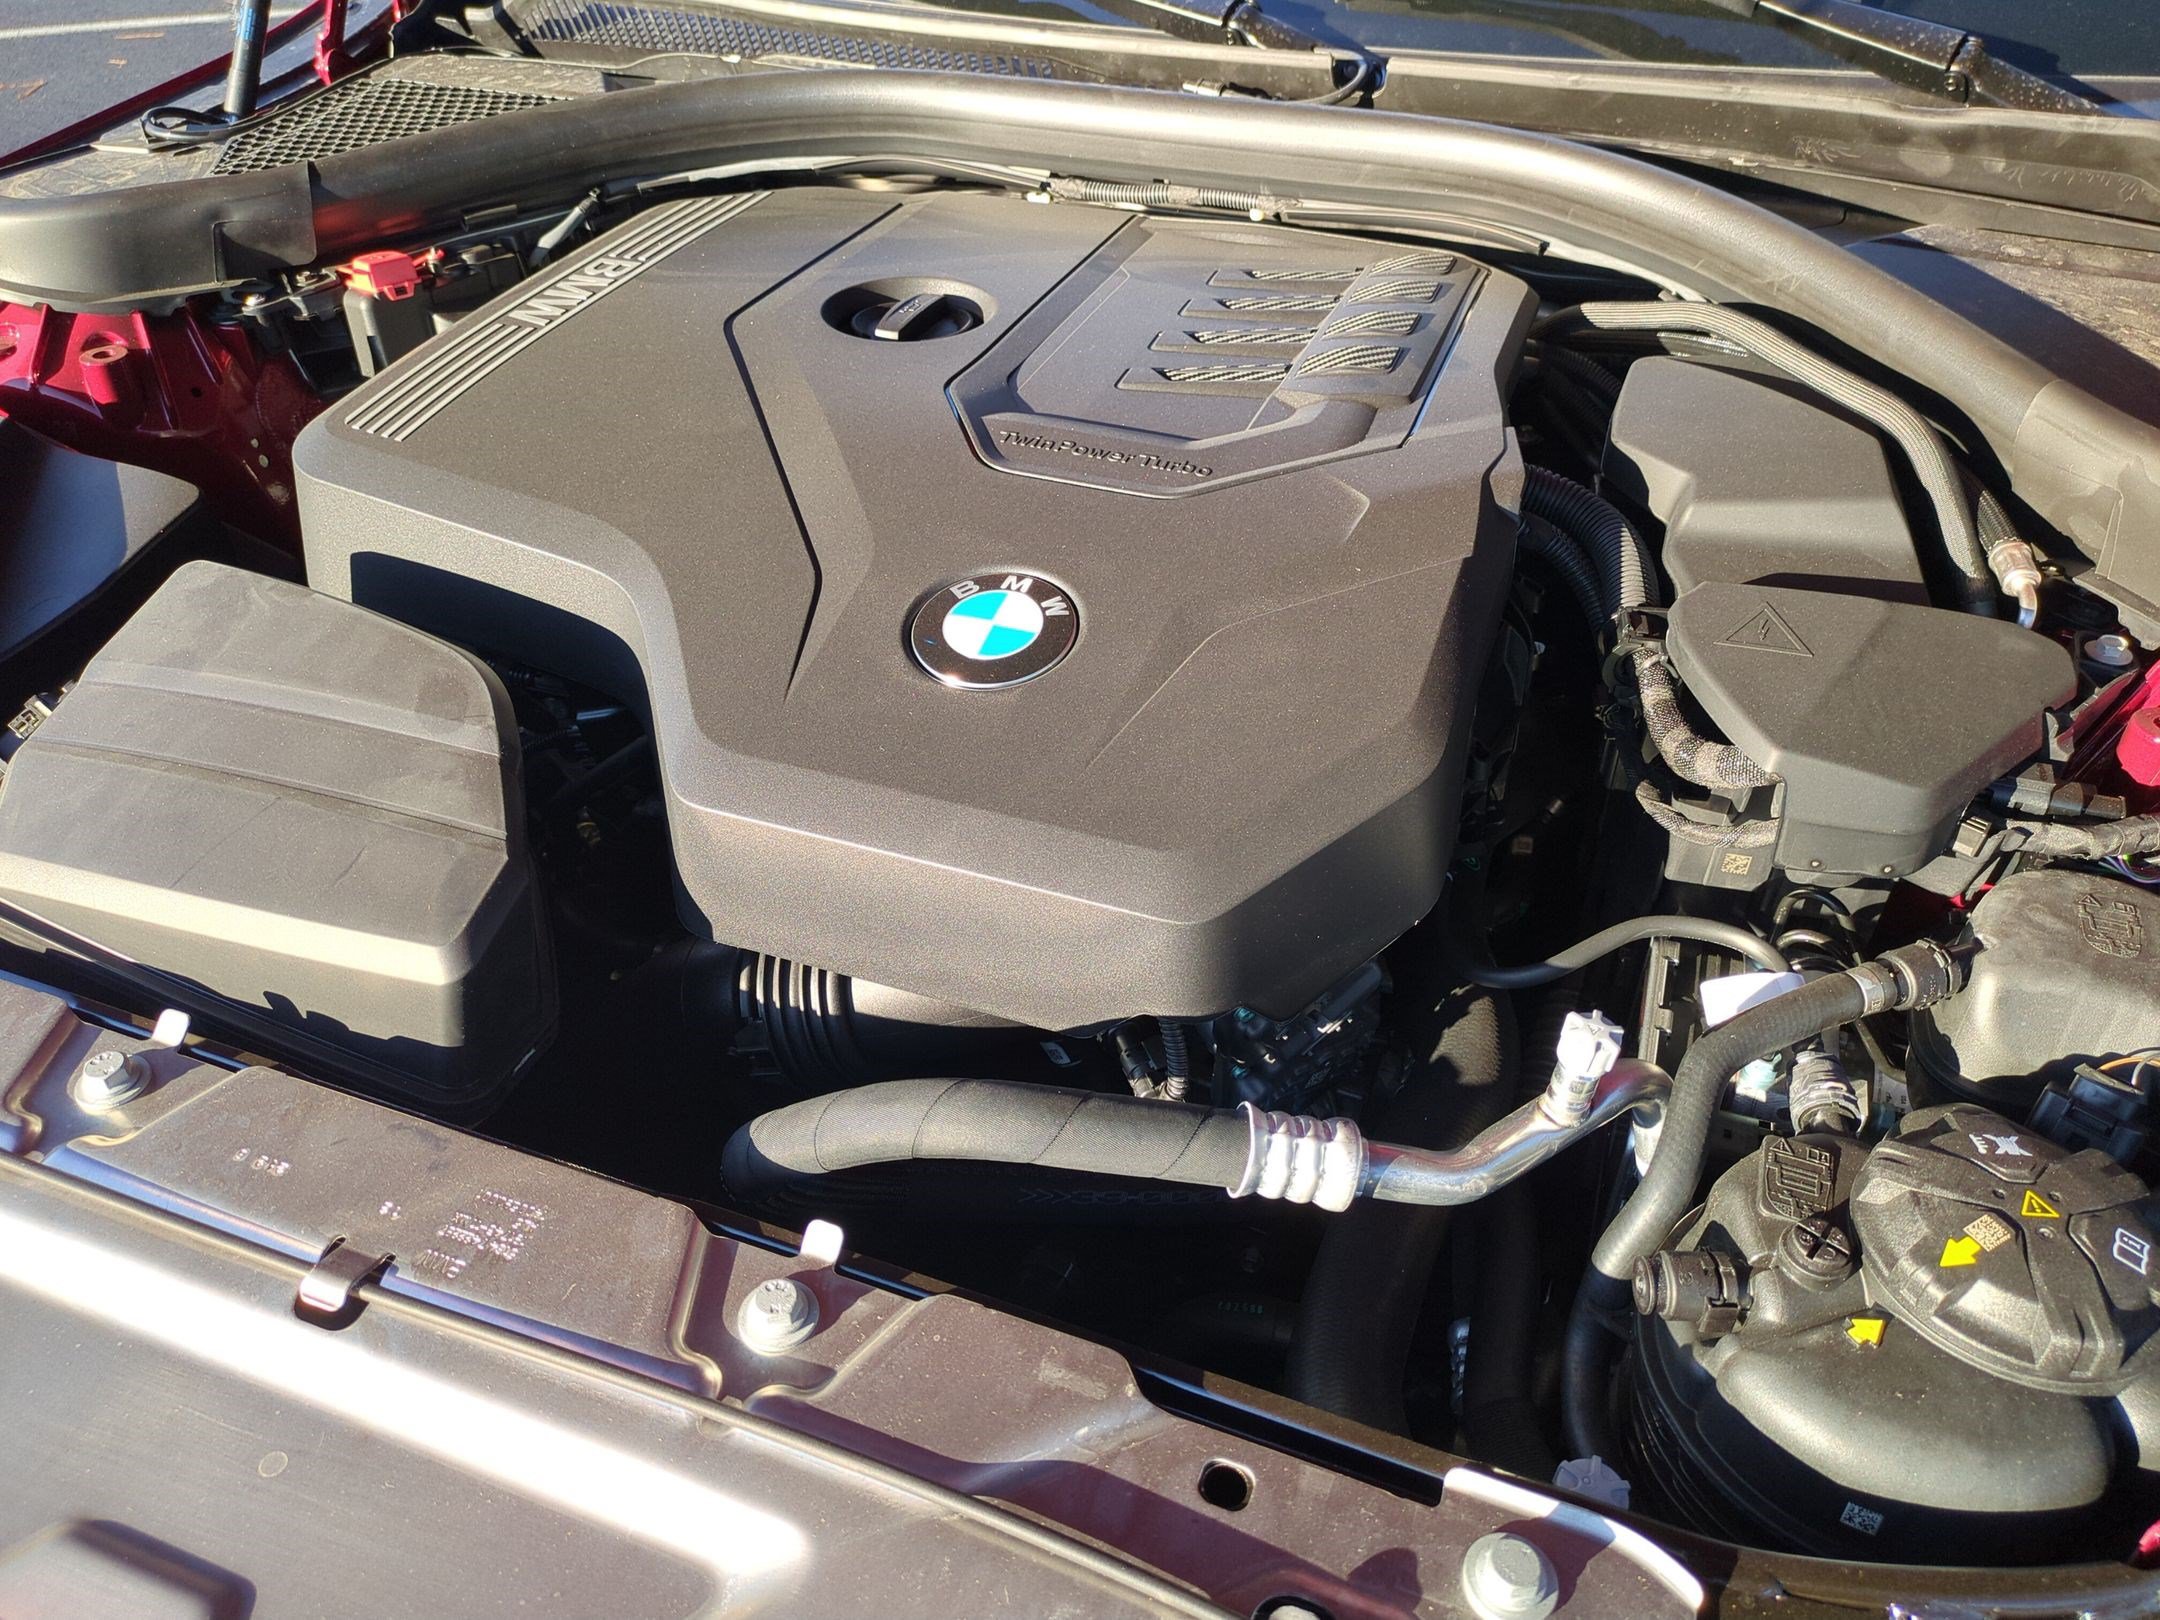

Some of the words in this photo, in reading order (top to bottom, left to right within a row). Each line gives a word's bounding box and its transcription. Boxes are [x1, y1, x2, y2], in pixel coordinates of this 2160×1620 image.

[508, 257, 642, 327] BMW
[999, 431, 1136, 465] TwinPower
[1139, 454, 1213, 477] Turbo
[949, 575, 1069, 617] BMW
